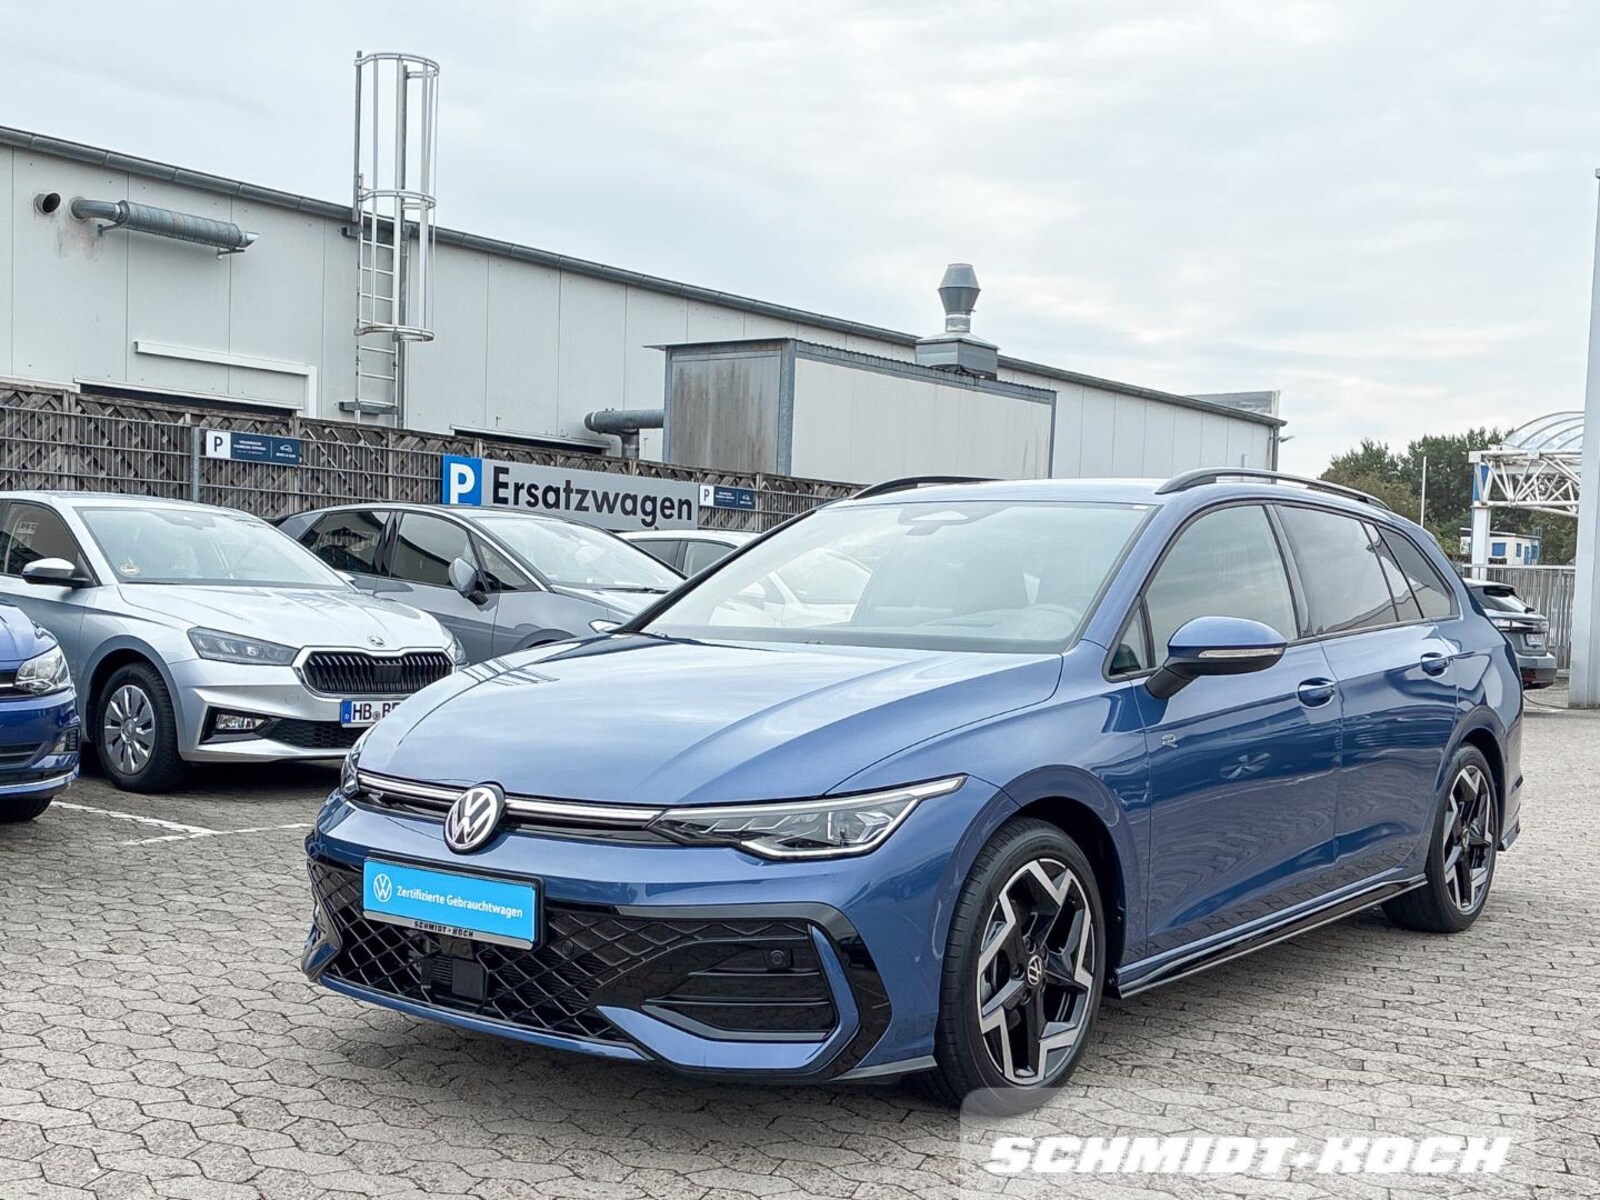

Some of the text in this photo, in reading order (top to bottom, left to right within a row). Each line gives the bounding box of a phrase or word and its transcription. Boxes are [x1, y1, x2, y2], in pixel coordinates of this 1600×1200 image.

[213, 435, 223, 452] P
[449, 462, 693, 527] P Ersatzwagen
[352, 703, 372, 720] HB
[396, 885, 523, 919] Zertifizierte Gebrauchtwagen
